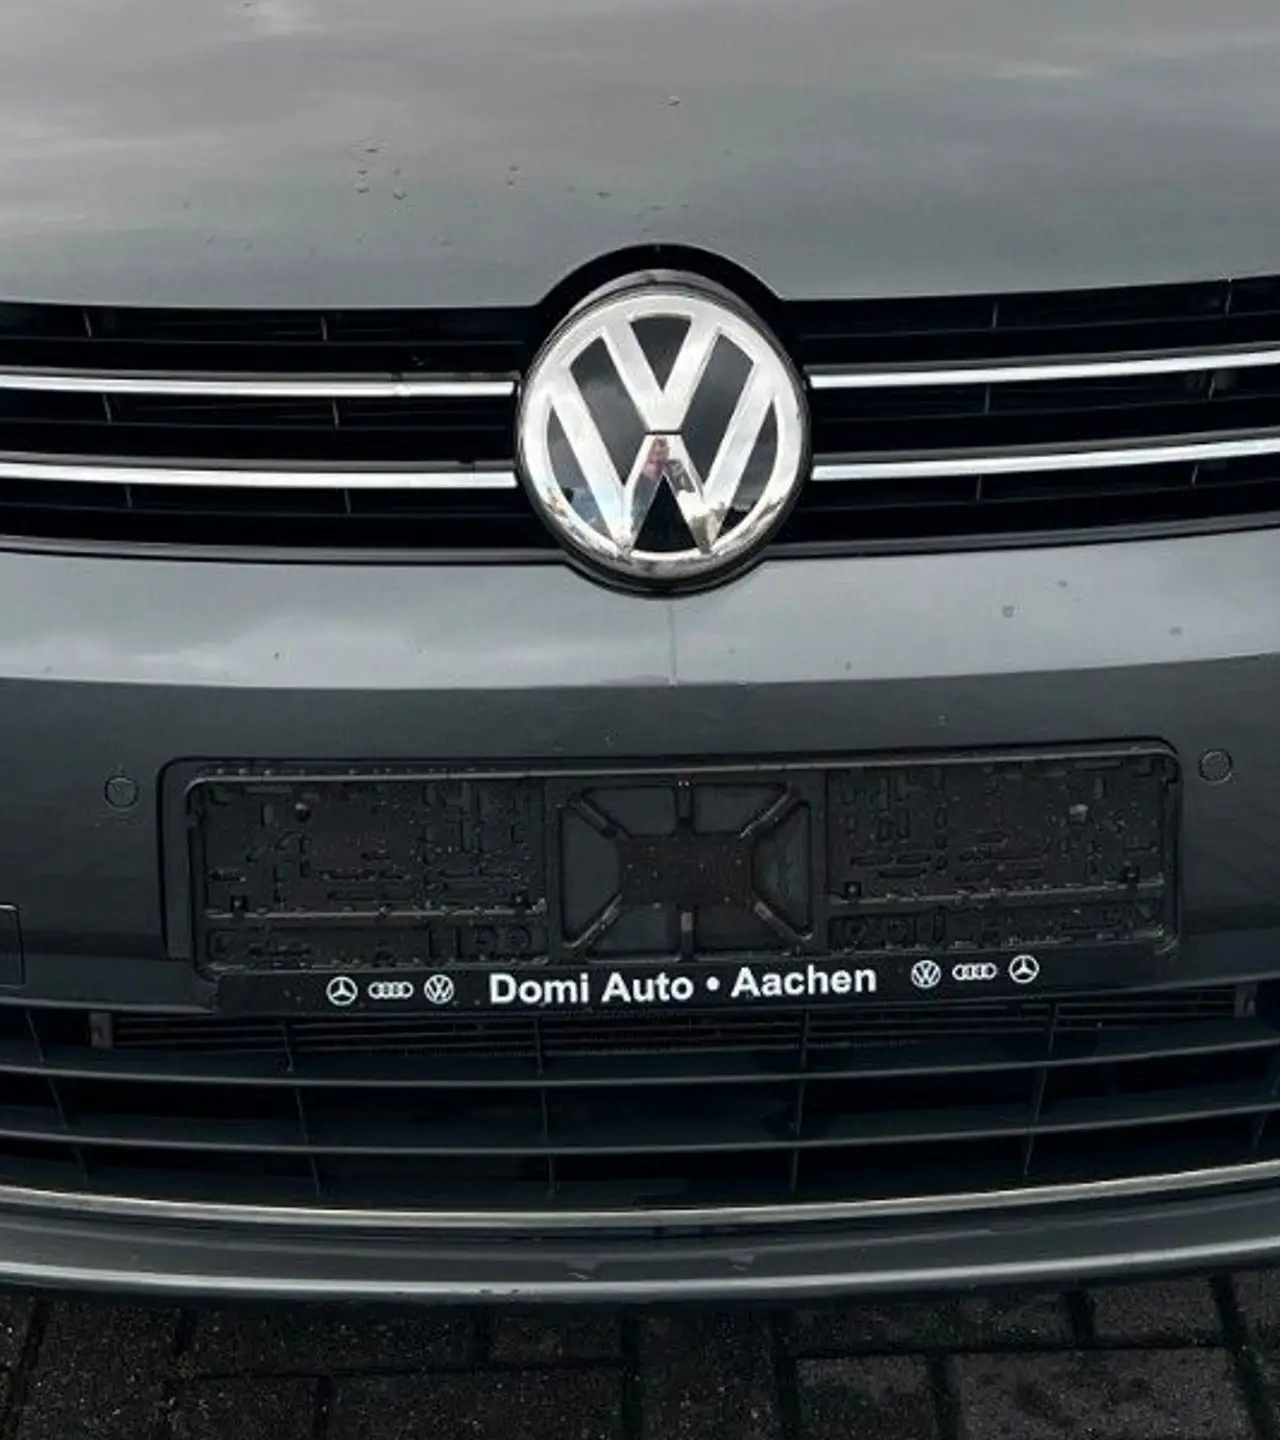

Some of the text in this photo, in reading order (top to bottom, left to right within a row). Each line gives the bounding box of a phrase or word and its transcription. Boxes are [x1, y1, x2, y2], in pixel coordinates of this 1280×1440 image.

[489, 964, 877, 1004] Domi Auto Aachen
